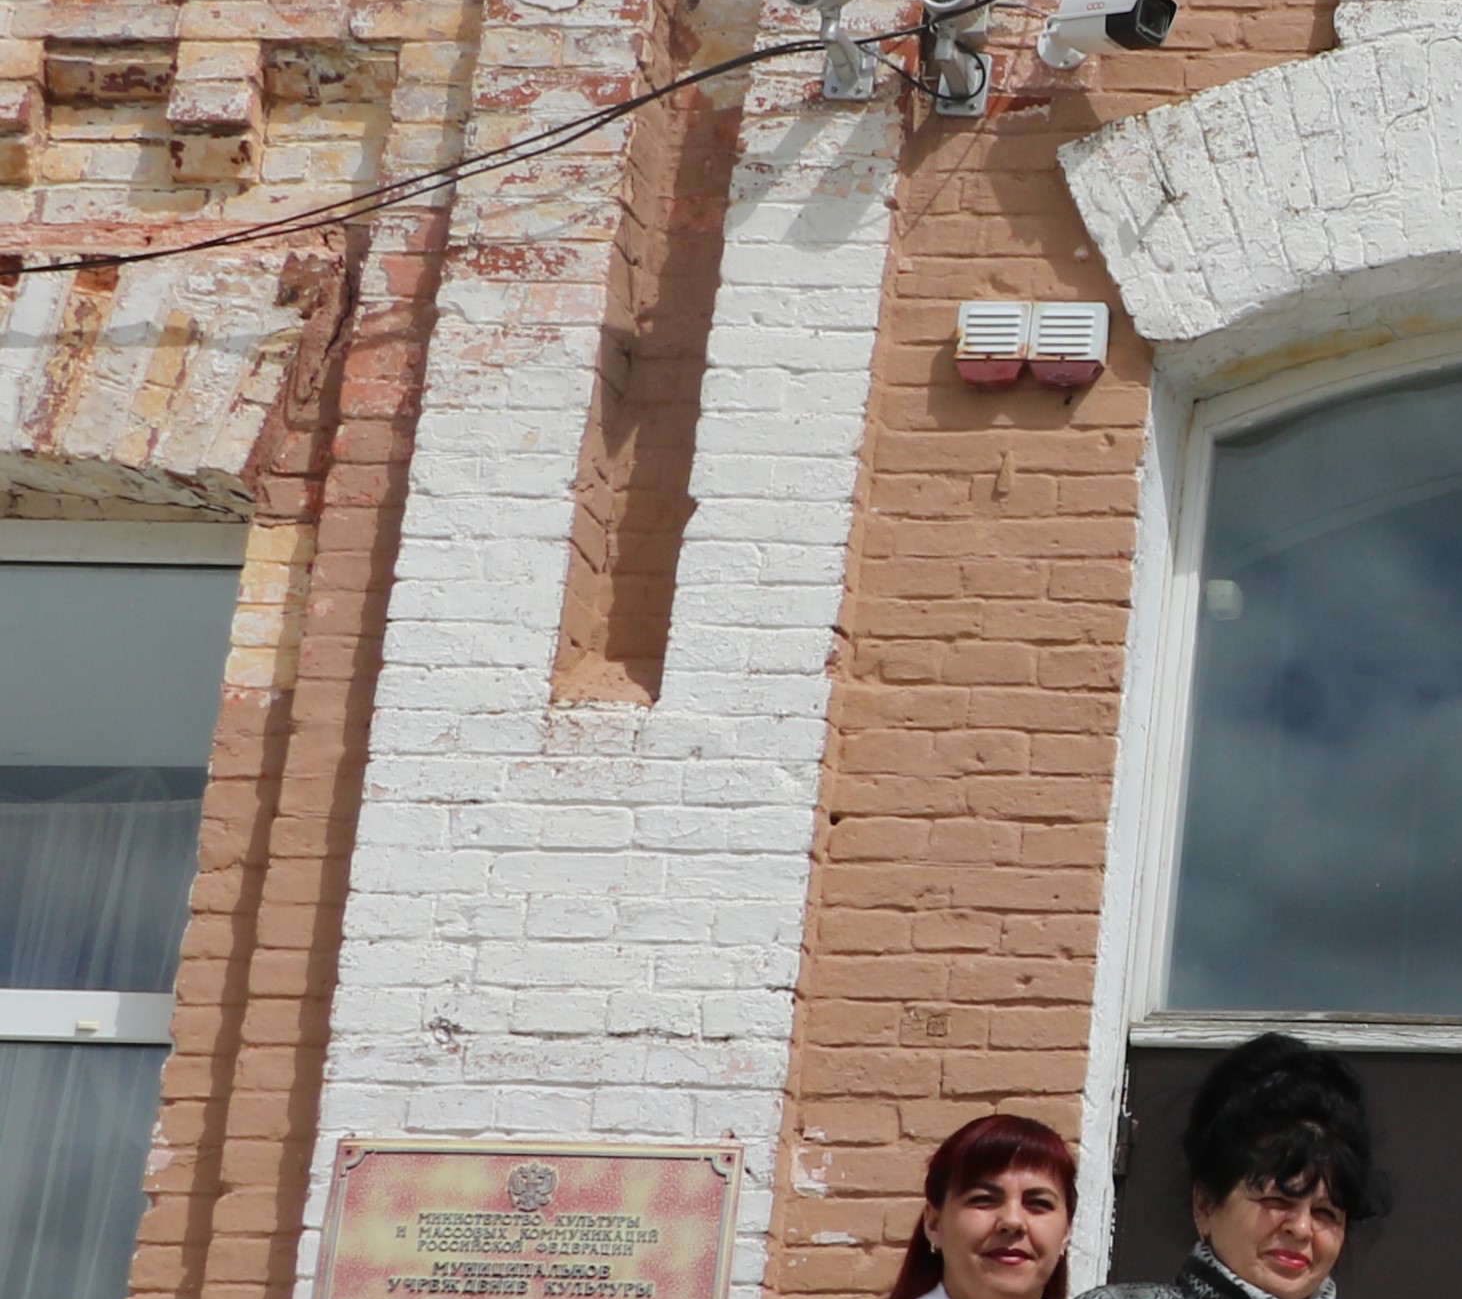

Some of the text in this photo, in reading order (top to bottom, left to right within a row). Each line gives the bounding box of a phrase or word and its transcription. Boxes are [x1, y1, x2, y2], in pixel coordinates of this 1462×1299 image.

[417, 1212, 641, 1229] МИНИСТЕРСТВО КУЛЬТУРЫ
[395, 1225, 659, 1243] И МАССОВЫХ КОММУНИКАЦИЙ
[417, 1238, 634, 1256] РОССИЙСКОЙ ФЕДЕРАЦИИ
[432, 1260, 612, 1280] МУНИЦИПАЛЬНОЕ
[387, 1276, 655, 1298] УЧРЕЖДЕНИЕ КУЛЬТУРЫ
